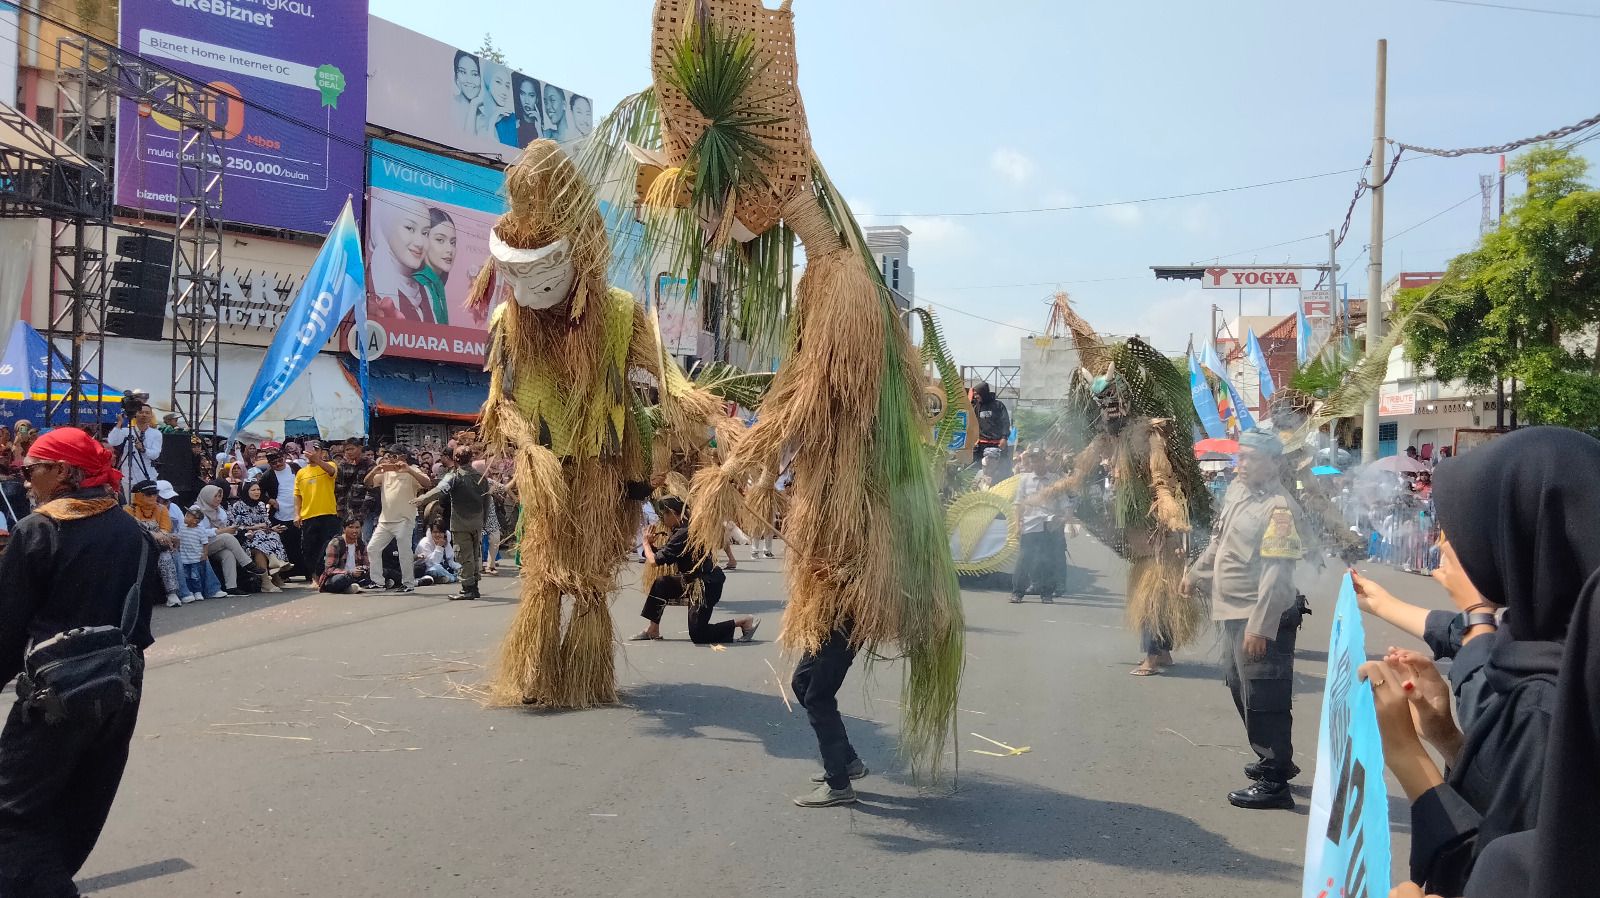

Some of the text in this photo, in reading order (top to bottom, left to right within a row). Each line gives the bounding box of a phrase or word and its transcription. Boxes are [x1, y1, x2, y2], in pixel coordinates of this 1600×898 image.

[150, 37, 188, 54] Biznet
[191, 46, 226, 62] Home
[229, 55, 273, 74] Internet
[319, 72, 339, 80] BEST
[319, 80, 340, 90] DEAL
[147, 148, 174, 159] mulai
[1232, 272, 1298, 285] YOGYA
[296, 291, 334, 346] bjb
[390, 332, 450, 352] MUARA
[453, 339, 488, 356] BAN
